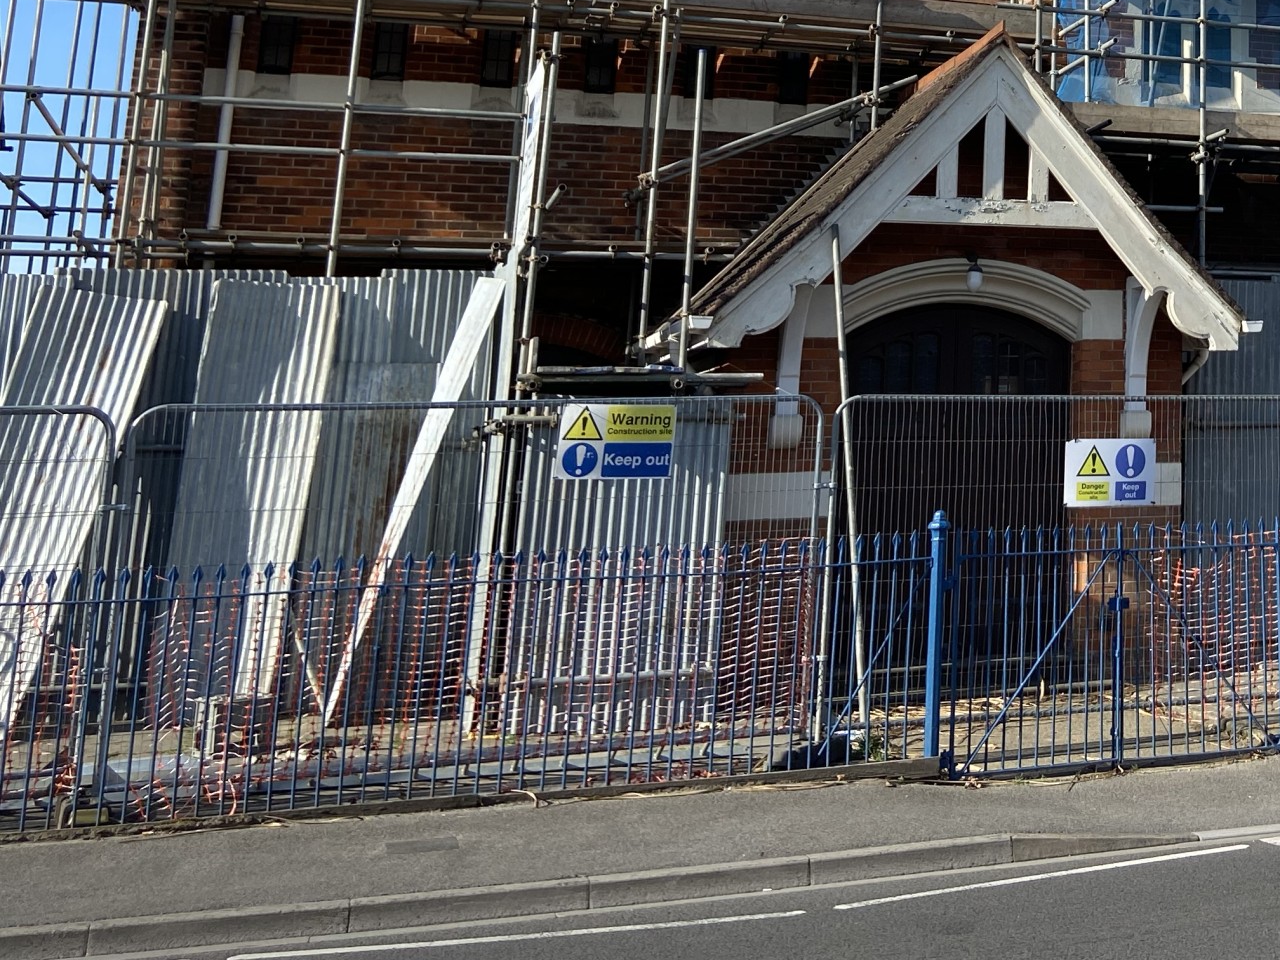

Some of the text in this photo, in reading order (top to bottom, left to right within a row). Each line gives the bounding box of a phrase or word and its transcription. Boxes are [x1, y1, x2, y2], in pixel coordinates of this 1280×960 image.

[612, 414, 671, 428] Warning
[604, 453, 670, 469] Keep out
[1122, 483, 1140, 491] Keep
